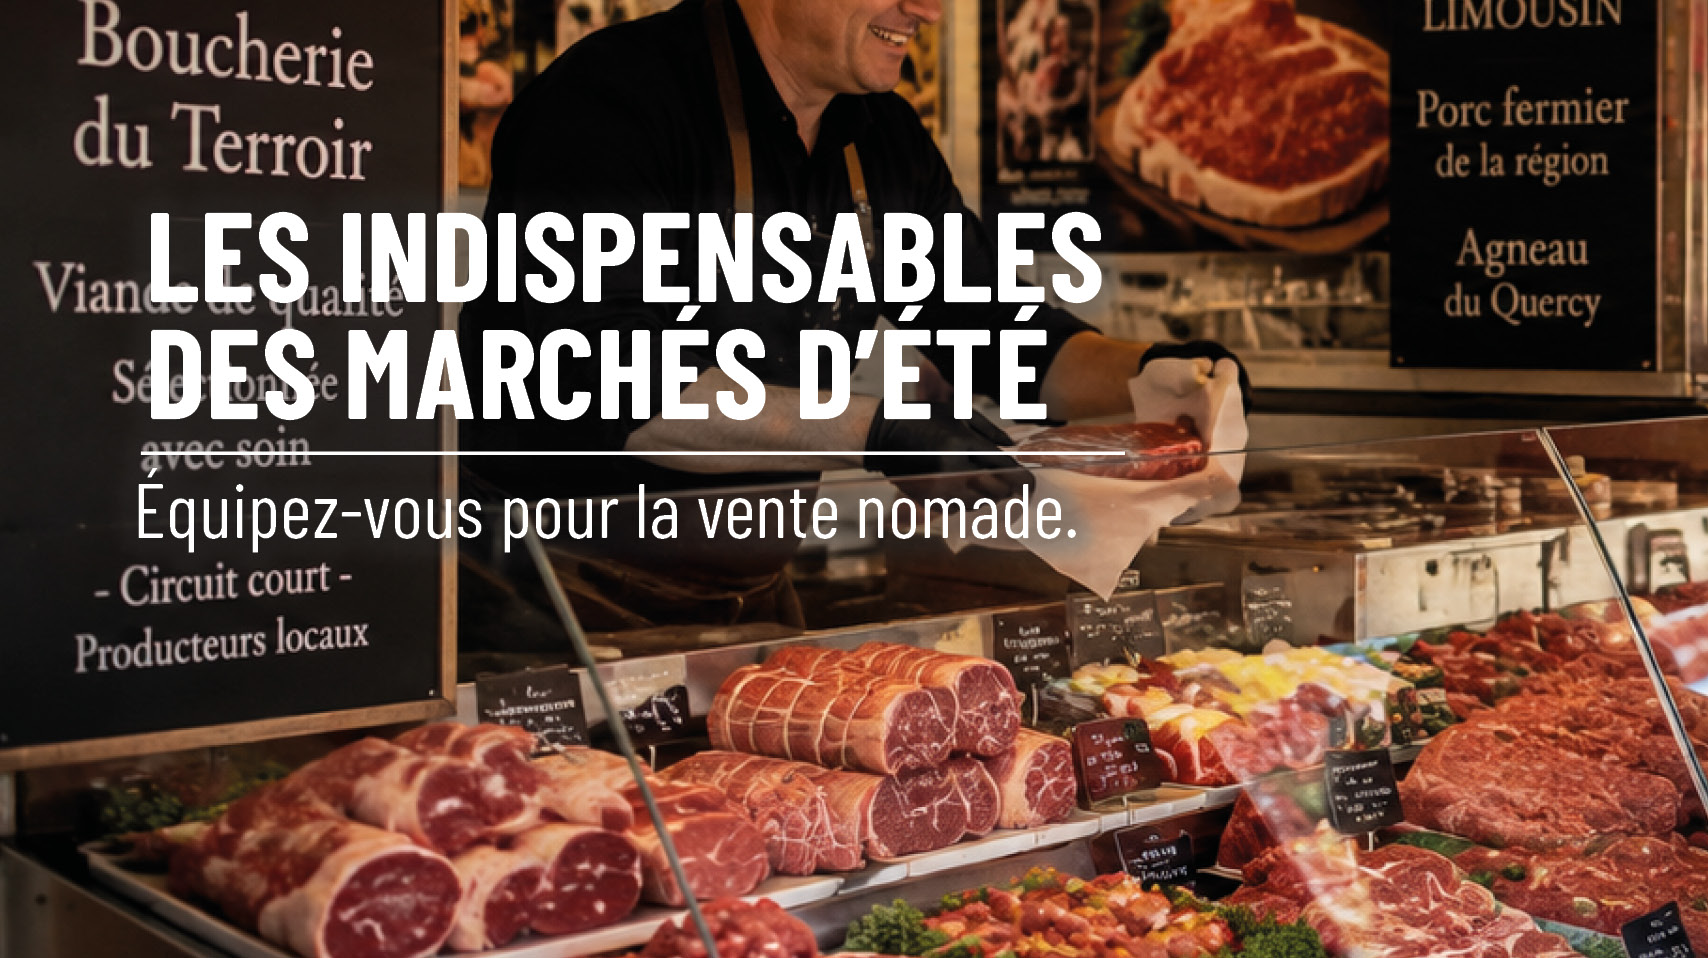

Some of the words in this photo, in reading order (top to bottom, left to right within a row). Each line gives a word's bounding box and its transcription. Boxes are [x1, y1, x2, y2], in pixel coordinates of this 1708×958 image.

[1422, 0, 1622, 31] LIMOUSIN
[77, 0, 375, 92] Boucherie
[1416, 90, 1492, 128] Porc
[1503, 85, 1630, 126] fermier
[73, 93, 154, 169] du
[170, 101, 374, 181] Terroir
[1436, 142, 1470, 178] de
[1480, 142, 1506, 177] la
[1514, 142, 1610, 187] région
[1456, 228, 1589, 278] Agneau
[269, 268, 404, 330] quaié
[1444, 281, 1482, 317] du
[1490, 282, 1602, 328] Quercy
[112, 358, 339, 405] Séeonée
[141, 439, 226, 472] avec
[235, 424, 312, 469] soin
[119, 561, 239, 607] Circuit
[247, 561, 331, 598] court
[75, 625, 268, 673] Producteurs
[275, 615, 371, 654] locaux
